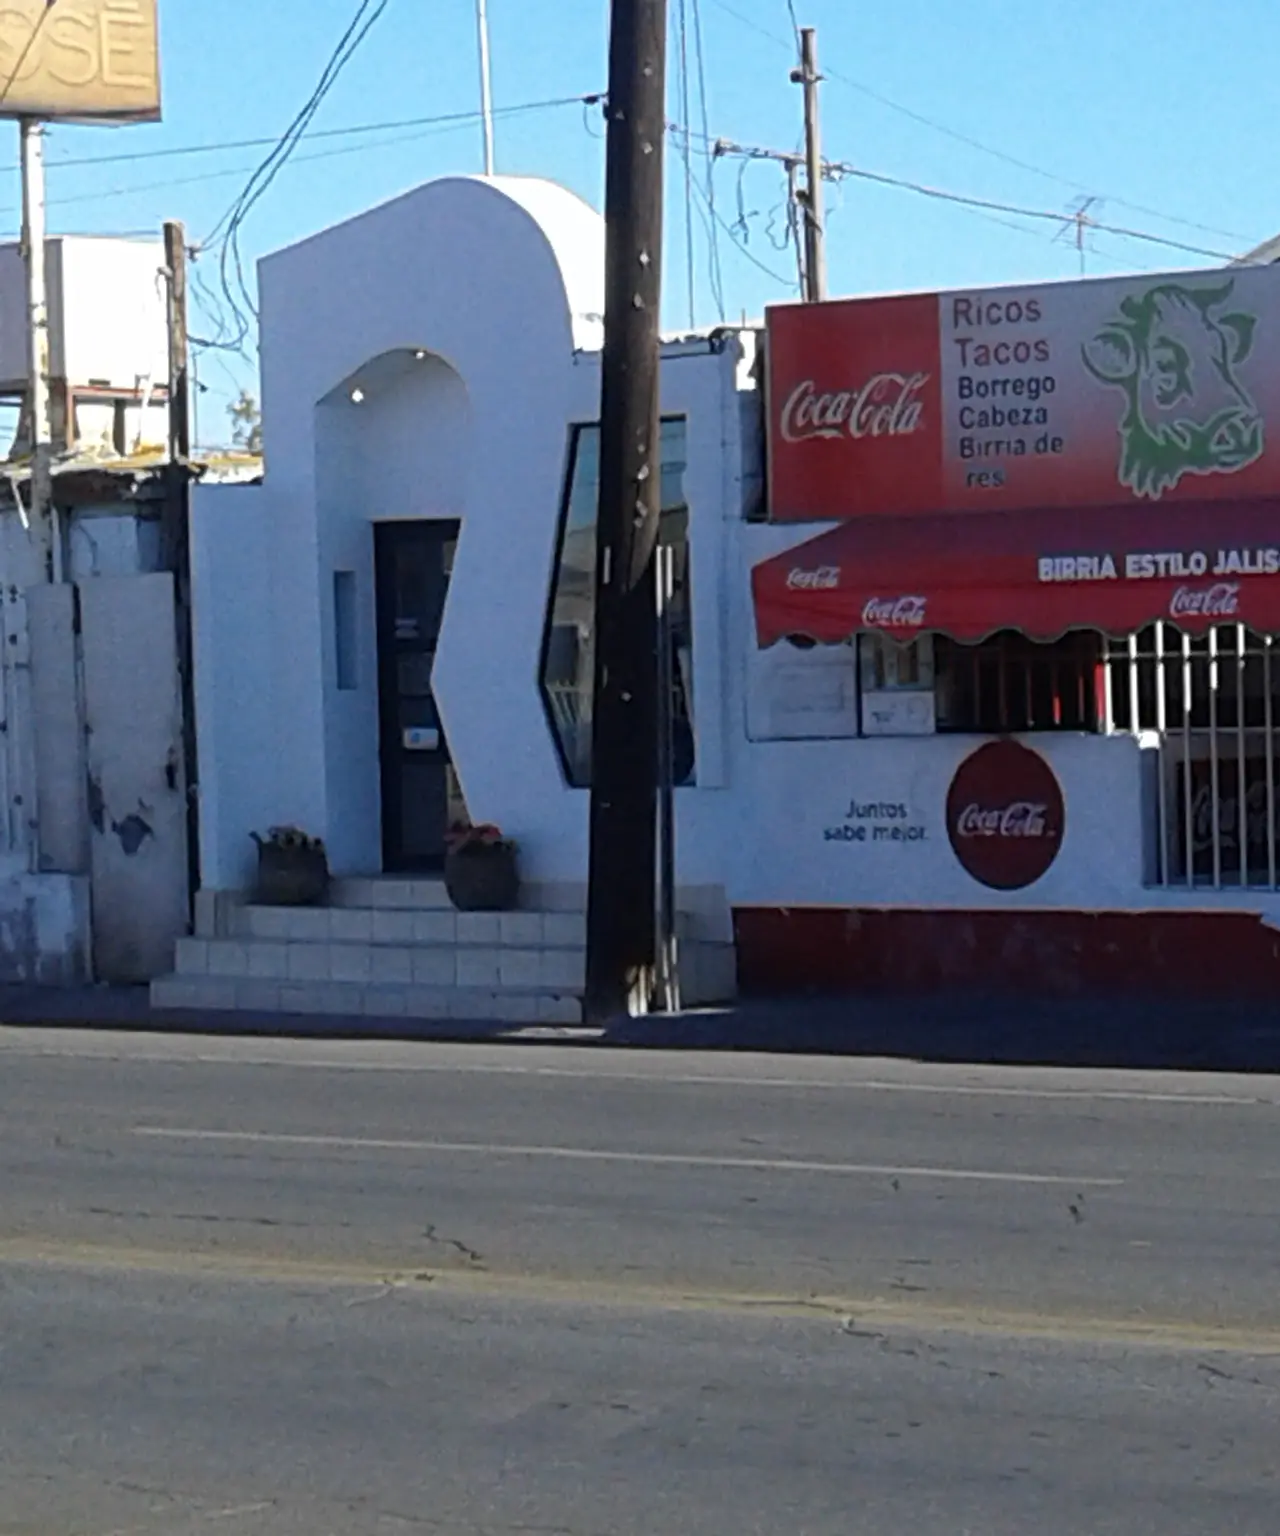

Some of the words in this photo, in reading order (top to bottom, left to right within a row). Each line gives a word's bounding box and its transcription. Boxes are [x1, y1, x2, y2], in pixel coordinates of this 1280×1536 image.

[953, 297, 1041, 329] Ricos
[954, 337, 1050, 368] Tacos
[958, 375, 1056, 401] Borrego
[959, 405, 1048, 429] Cabeza
[960, 436, 1026, 459] Birria
[1034, 432, 1064, 453] de
[966, 470, 1004, 488] res
[1038, 555, 1117, 582] BIRRIA
[1126, 552, 1208, 579] ESTILO
[845, 798, 907, 819] Juntos
